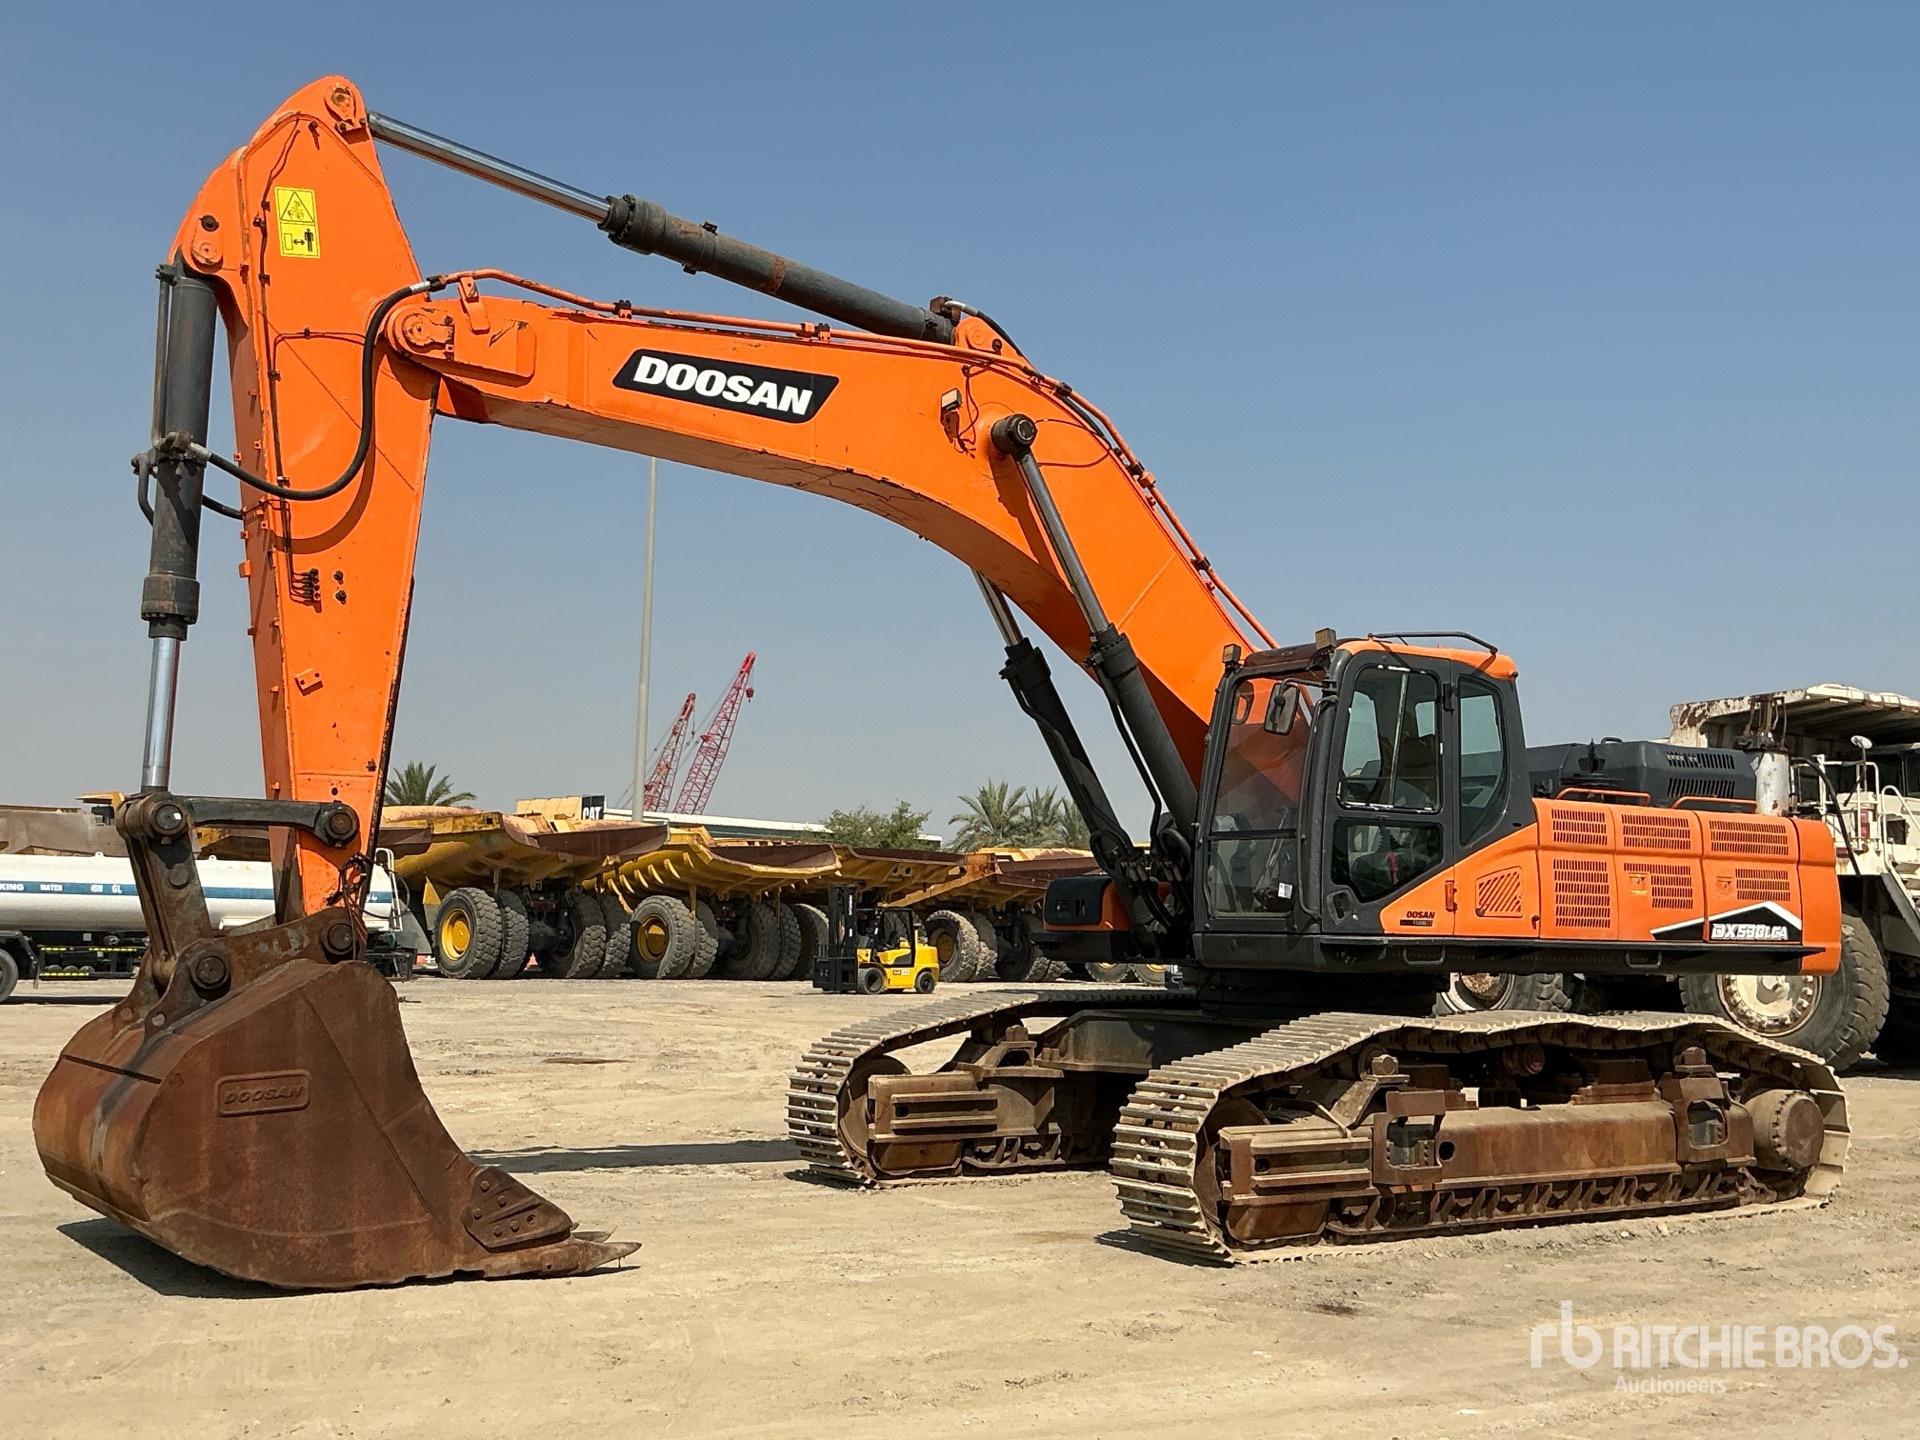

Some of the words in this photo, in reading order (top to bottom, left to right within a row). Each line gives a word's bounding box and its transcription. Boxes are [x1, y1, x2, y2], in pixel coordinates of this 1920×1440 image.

[633, 355, 813, 415] DOOSAN
[582, 806, 602, 820] CAT
[224, 1085, 304, 1105] DOOSAN
